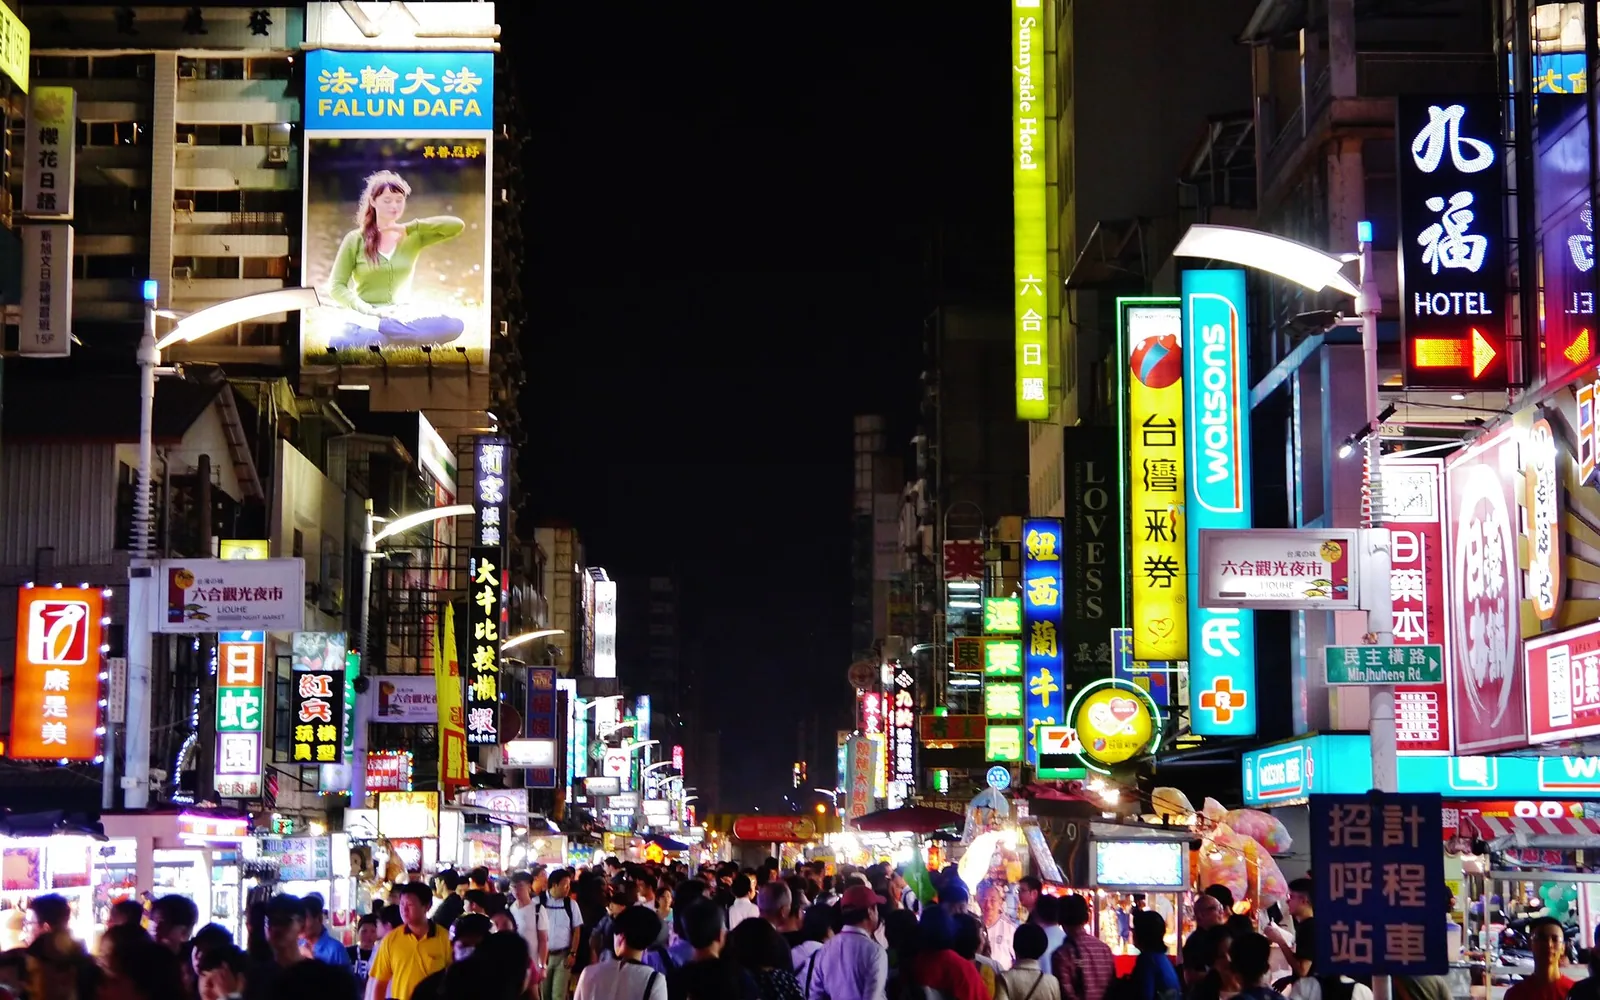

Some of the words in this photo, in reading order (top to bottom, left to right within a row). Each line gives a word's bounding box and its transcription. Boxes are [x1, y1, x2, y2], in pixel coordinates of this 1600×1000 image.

[318, 65, 483, 95] 法輪大法
[318, 98, 405, 116] FALUN
[413, 98, 482, 116] DAFA
[1014, 17, 1036, 112] Sunnyside
[1019, 118, 1037, 170] Hotel
[1411, 104, 1494, 275] 九福
[1020, 273, 1045, 401] 六合日麗
[1415, 292, 1492, 316] HOTEL
[1201, 323, 1229, 484] watsons
[1083, 461, 1108, 619] LOVESS
[1142, 413, 1180, 588] 台灣彩券
[192, 587, 283, 602] 六合觀光夜市
[1221, 560, 1323, 577] 六合觀光夜市
[472, 556, 500, 702] 大牛比較懶
[1344, 648, 1426, 665] 民主橫路
[1408, 667, 1423, 680] Rd.
[1328, 803, 1373, 965] 招呼站
[1382, 805, 1427, 967] 計程車
